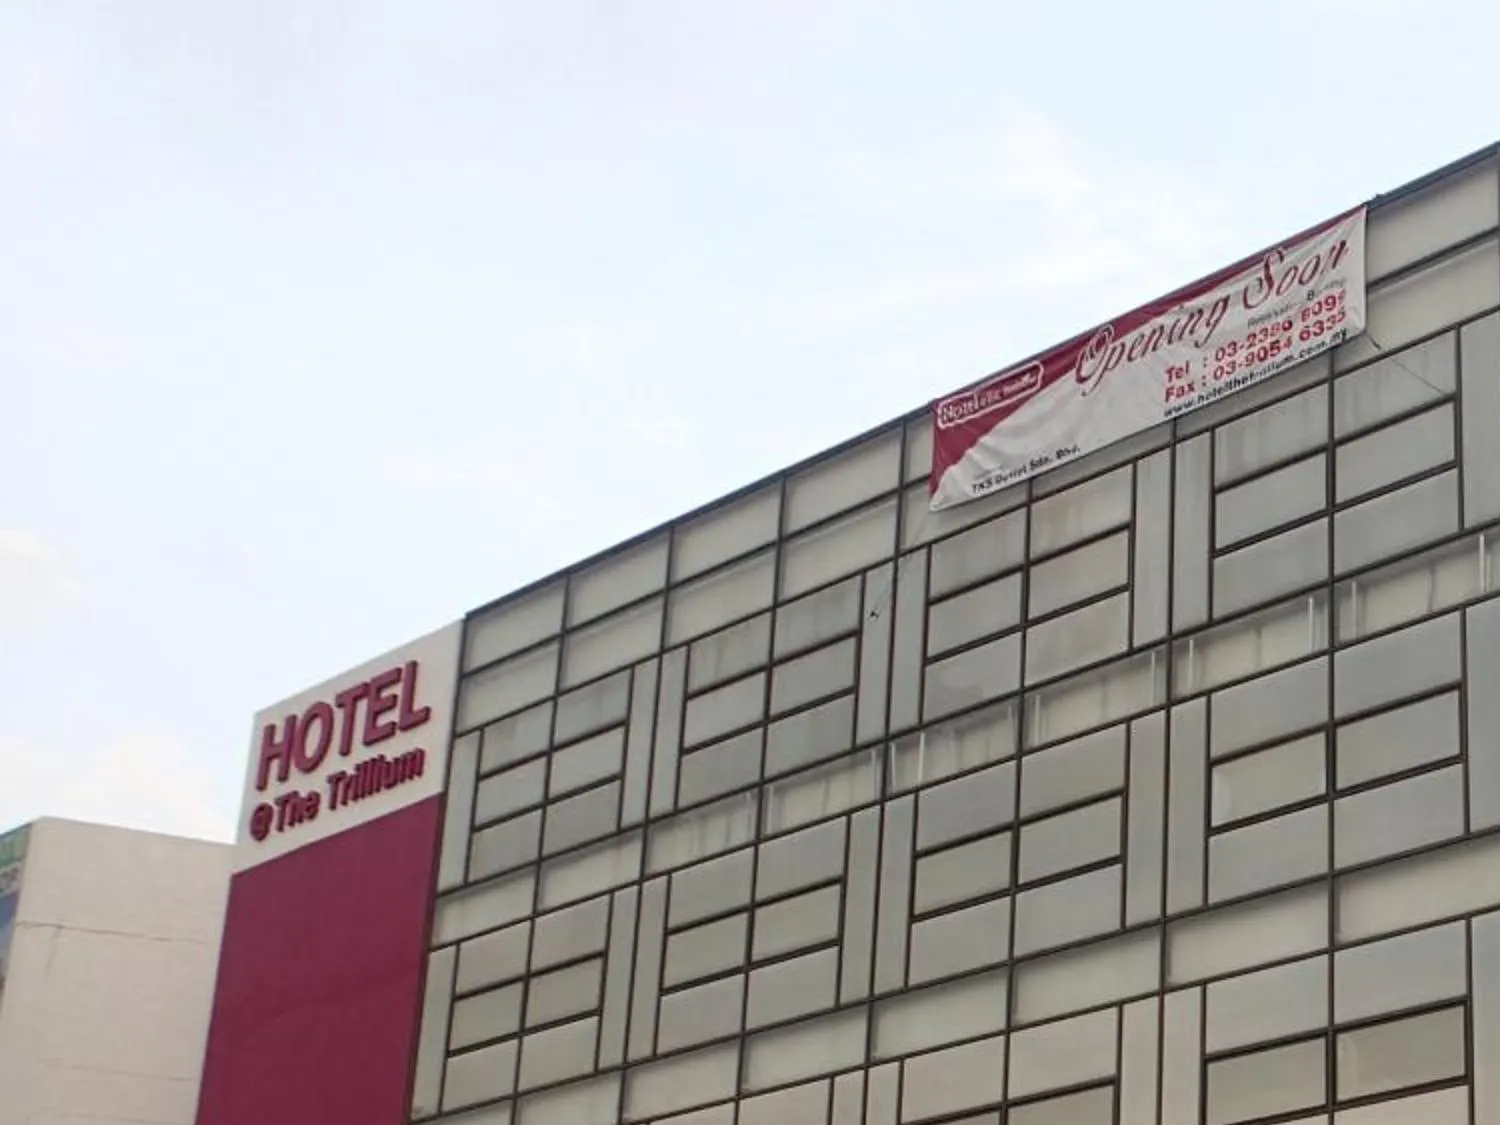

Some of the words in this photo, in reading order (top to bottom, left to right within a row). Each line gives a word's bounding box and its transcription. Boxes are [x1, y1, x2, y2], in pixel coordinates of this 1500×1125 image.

[1074, 293, 1230, 397] Opening
[1242, 239, 1349, 310] Soon
[1165, 361, 1190, 383] Tel
[1165, 382, 1195, 403] Fax
[256, 660, 431, 791] HOTEL
[327, 748, 426, 811] Trillium
